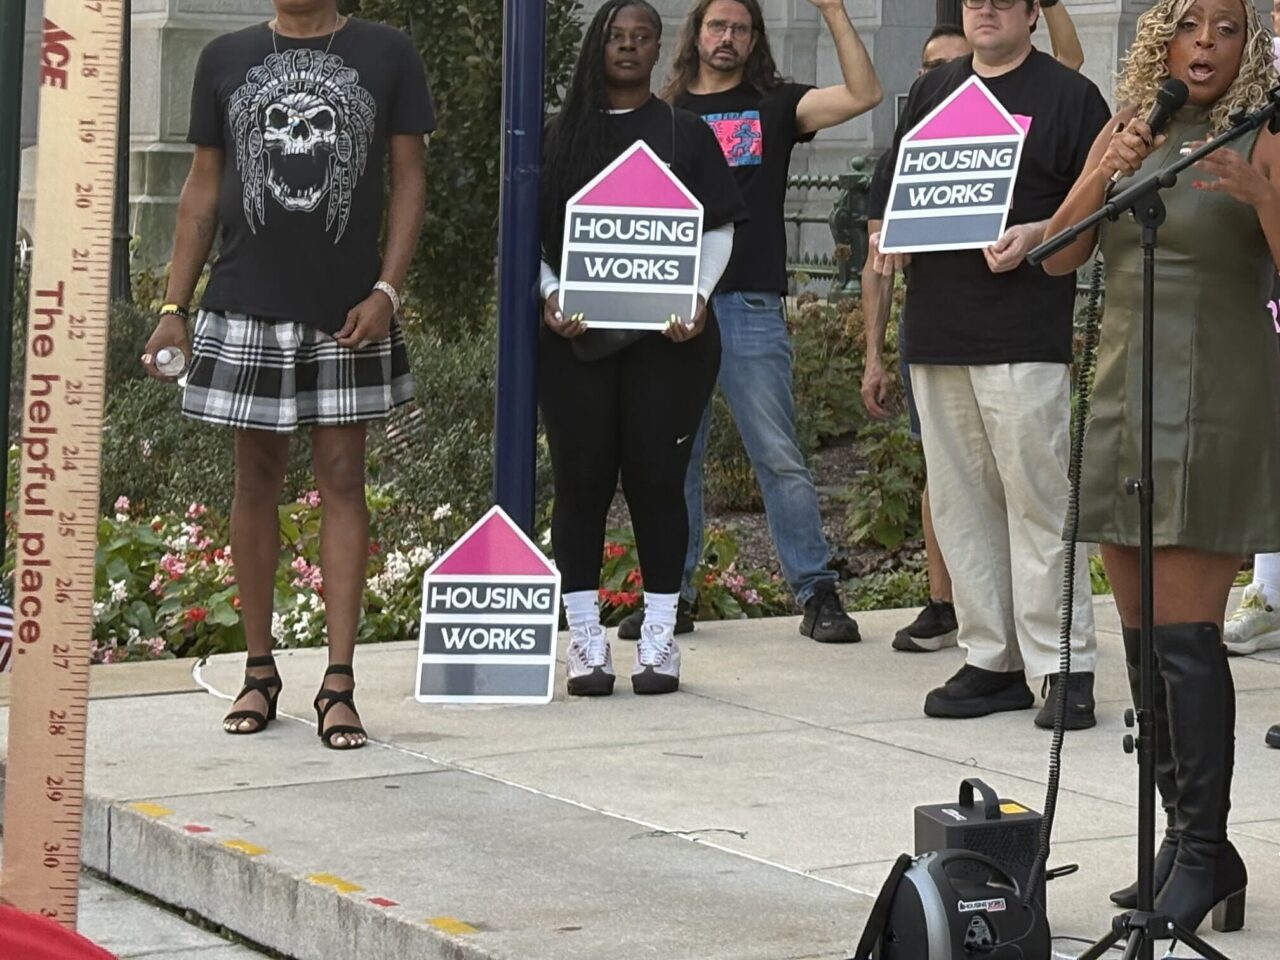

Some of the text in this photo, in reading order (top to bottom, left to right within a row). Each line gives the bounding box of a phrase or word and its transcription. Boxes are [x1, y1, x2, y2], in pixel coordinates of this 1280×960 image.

[40, 18, 74, 90] ACE
[903, 148, 1013, 172] HOUSING
[909, 183, 994, 207] WORKS
[574, 218, 694, 242] HOUSING
[584, 257, 679, 281] WORKS
[15, 281, 64, 655] The helpful place.
[431, 587, 550, 609] HOUSING
[441, 628, 535, 650] WORKS
